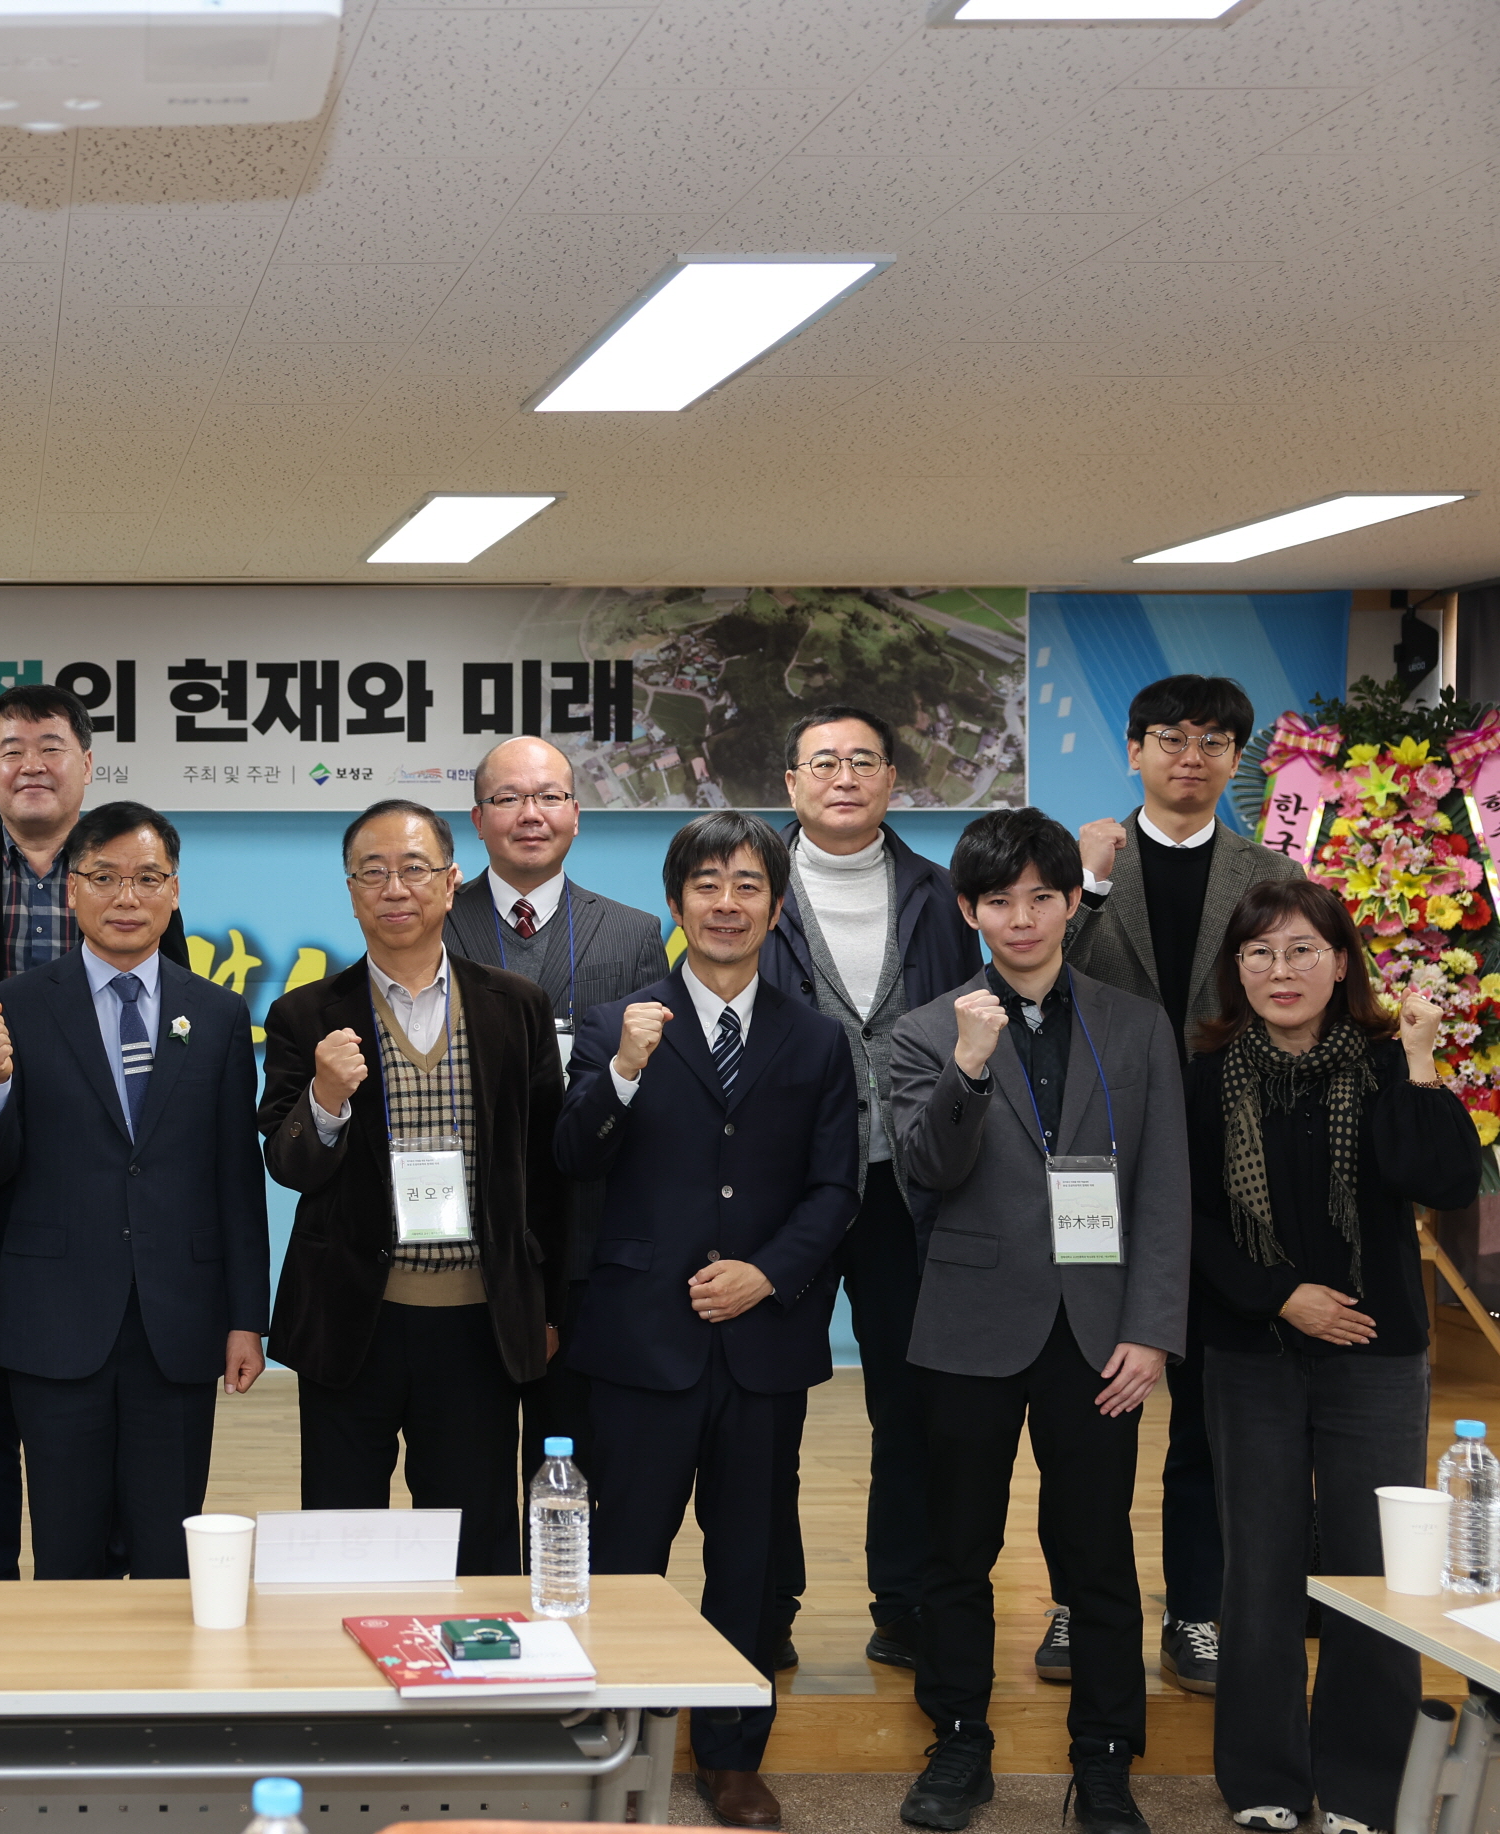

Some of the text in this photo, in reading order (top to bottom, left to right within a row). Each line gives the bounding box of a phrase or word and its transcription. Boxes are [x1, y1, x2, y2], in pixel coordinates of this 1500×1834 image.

[167, 658, 434, 744] 현재와
[462, 659, 634, 743] 미래
[182, 765, 282, 784] 주최 및 주관
[335, 767, 374, 782] 보성군
[1057, 1214, 1115, 1230] 鈴木崇司
